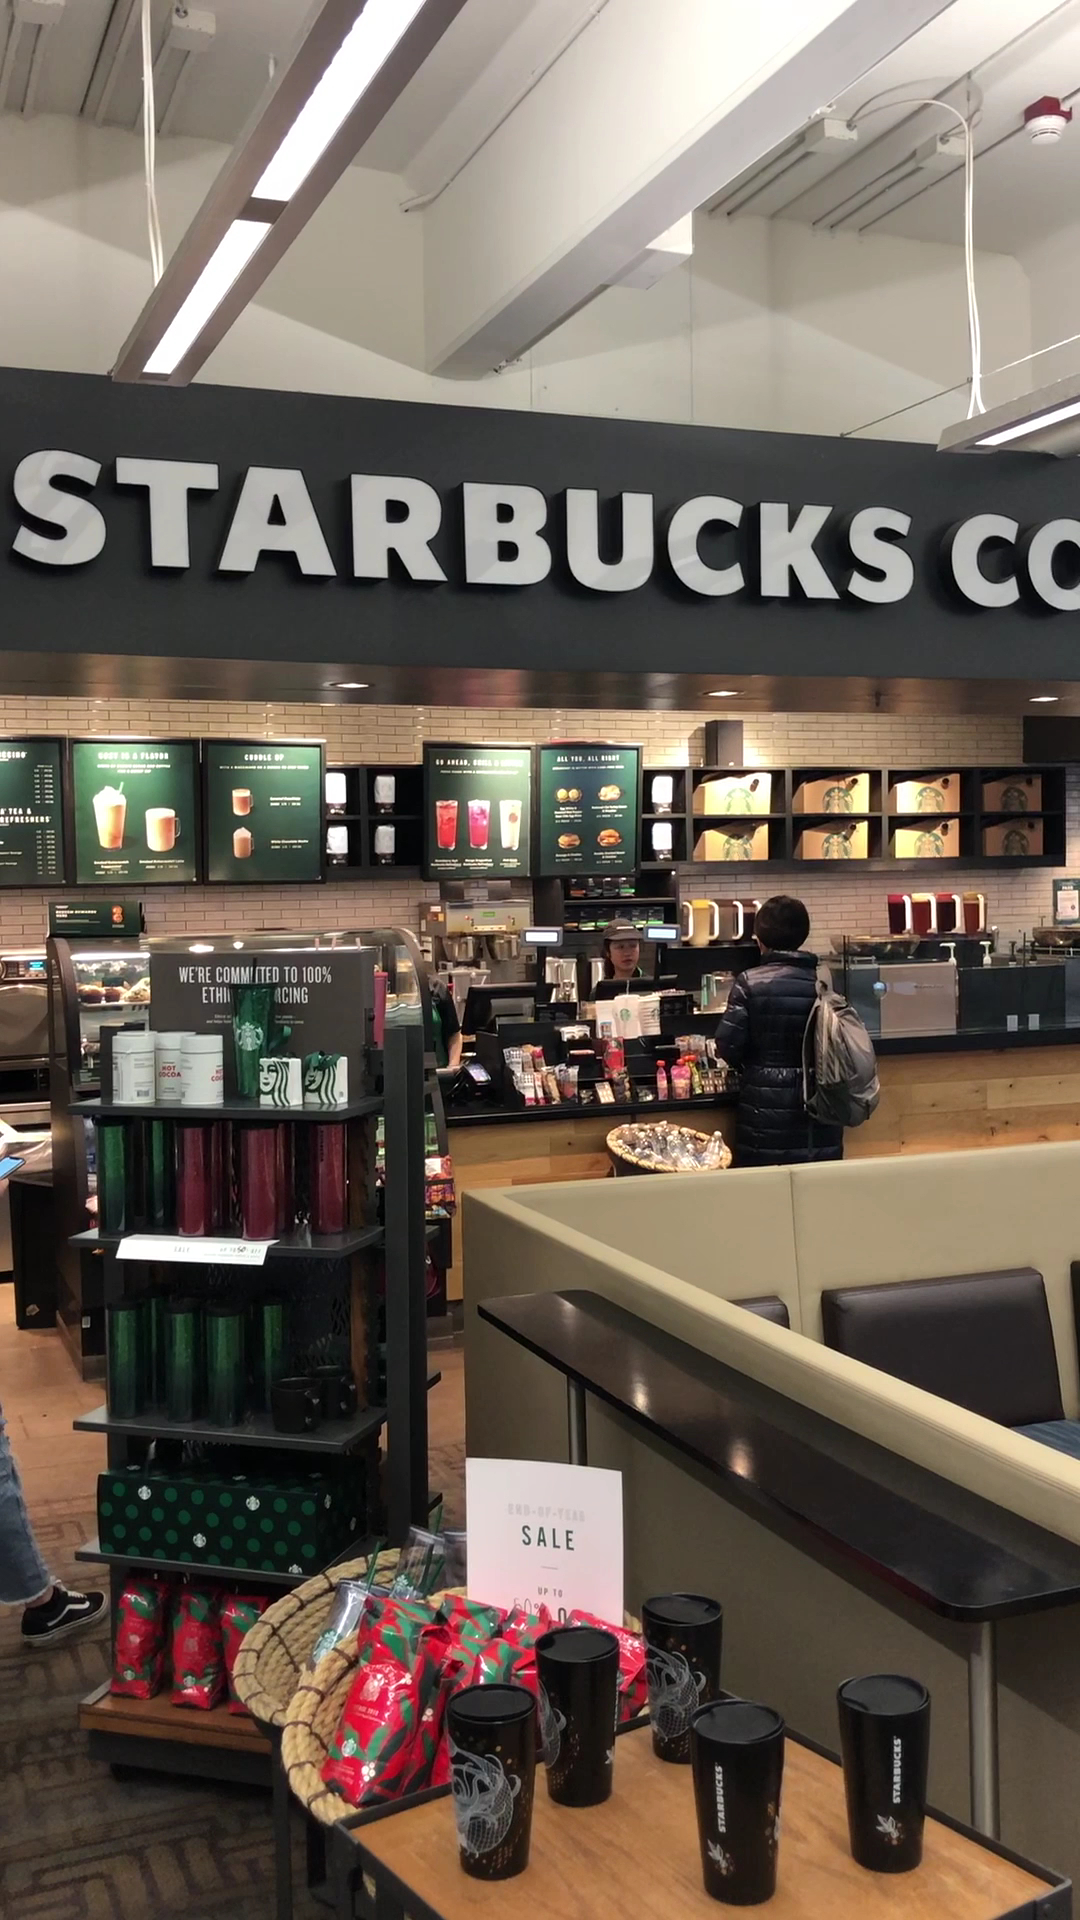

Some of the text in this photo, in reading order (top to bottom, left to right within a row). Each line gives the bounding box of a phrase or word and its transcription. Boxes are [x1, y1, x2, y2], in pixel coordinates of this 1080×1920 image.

[12, 448, 915, 604] STARBUCKS
[179, 966, 212, 983] WE'RE
[284, 966, 298, 983] TO
[302, 966, 332, 983] 100%
[522, 1525, 575, 1551] SALE
[537, 1587, 563, 1597] UP TO
[892, 1737, 902, 1804] STARBUCKS
[714, 1764, 727, 1833] STARBUCKS
